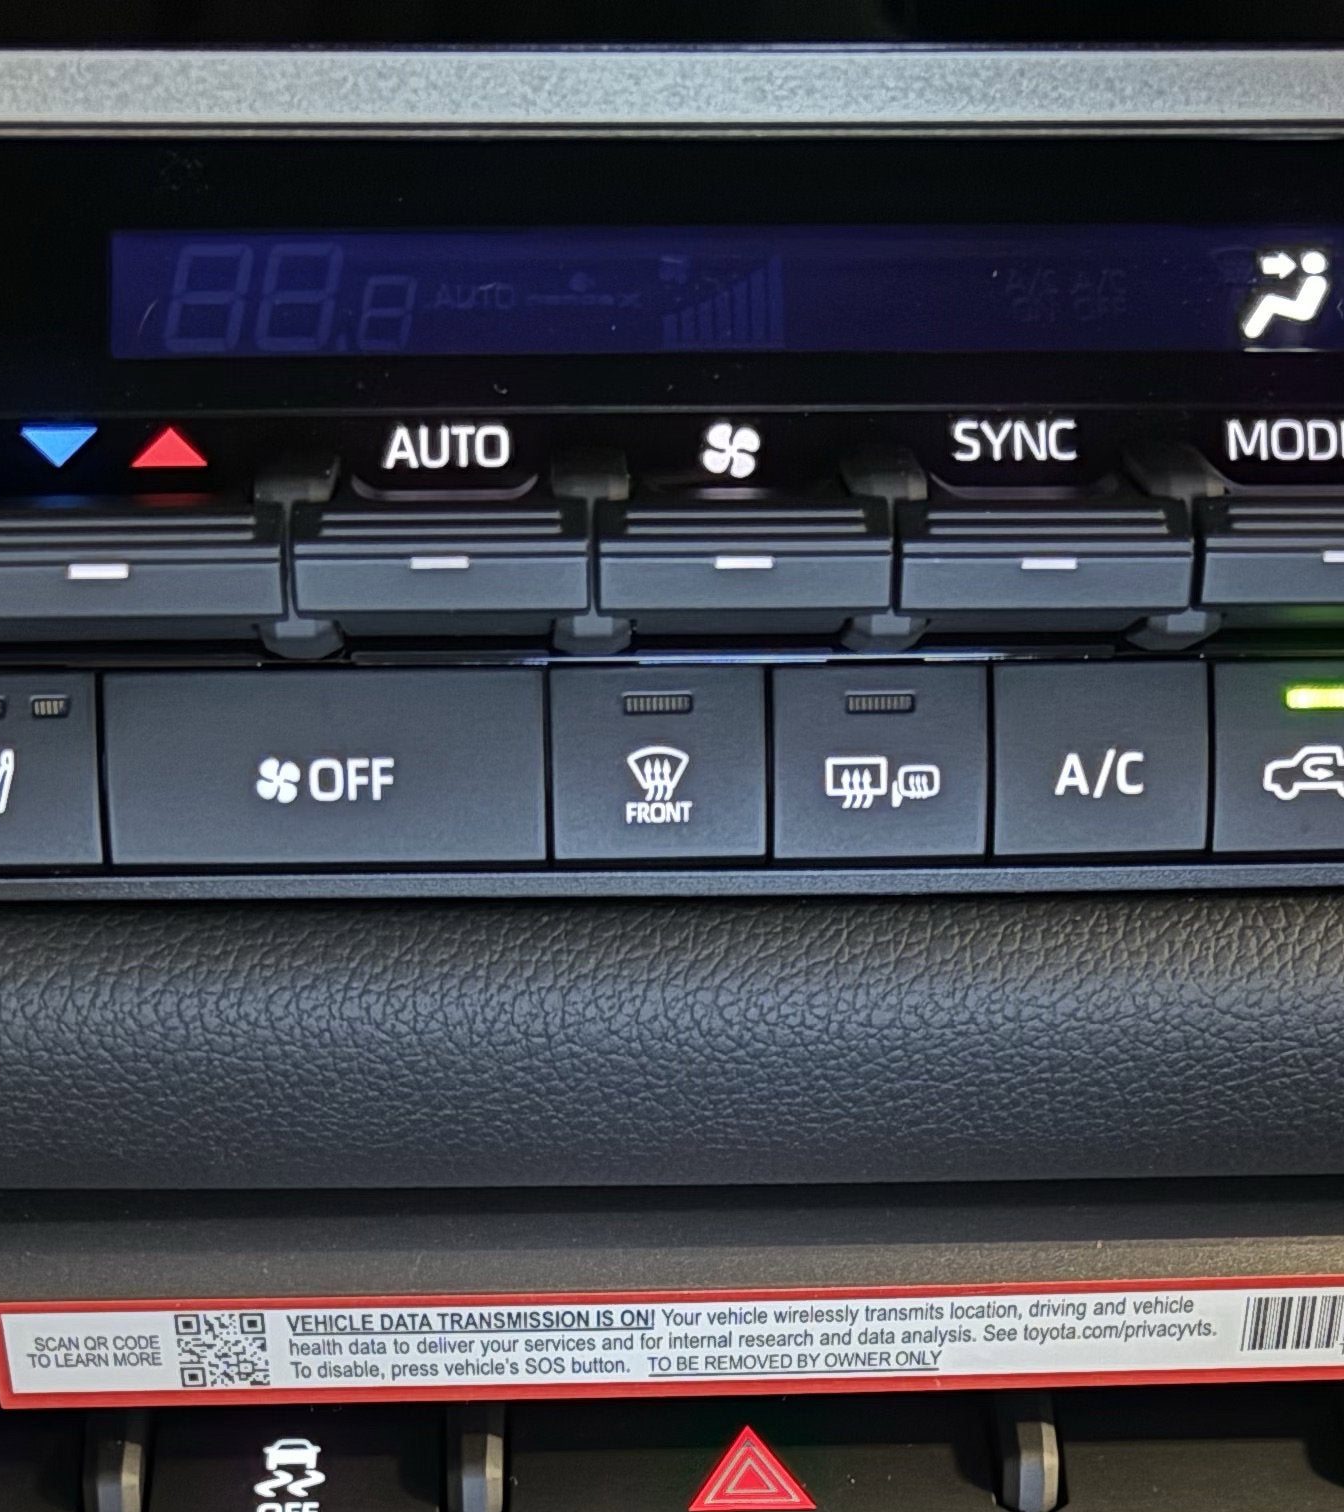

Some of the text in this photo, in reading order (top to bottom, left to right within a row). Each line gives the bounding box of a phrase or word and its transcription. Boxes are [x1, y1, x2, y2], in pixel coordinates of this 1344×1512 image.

[383, 424, 511, 471] AUTO
[951, 418, 1078, 462] SYNC
[308, 757, 396, 803] OFF
[1054, 749, 1146, 799] A/C
[625, 800, 693, 825] FRONT
[287, 1296, 1195, 1333] VEHICLE DATA TRANSMISSION IS ON! Your vehicle wirelessly transmits location, driving and vehicle
[27, 1352, 163, 1369] TO LEARN MORE
[34, 1335, 161, 1352] SCAN QR CODE
[288, 1338, 344, 1357] health
[348, 1337, 388, 1356] data
[393, 1338, 411, 1355] to
[416, 1336, 476, 1355] deliver
[480, 1338, 519, 1360] your
[524, 1335, 597, 1353] services
[602, 1333, 634, 1351] and
[639, 1332, 664, 1350] for
[668, 1331, 733, 1350] internal
[738, 1330, 814, 1348] research
[819, 1328, 852, 1347] and
[857, 1327, 896, 1346] data
[901, 1325, 977, 1348] analysis.
[983, 1325, 1018, 1342] See
[290, 1350, 943, 1383] To disable, press vehicle's SOS button. TO BE REMOVED BY OWNER ONLY
